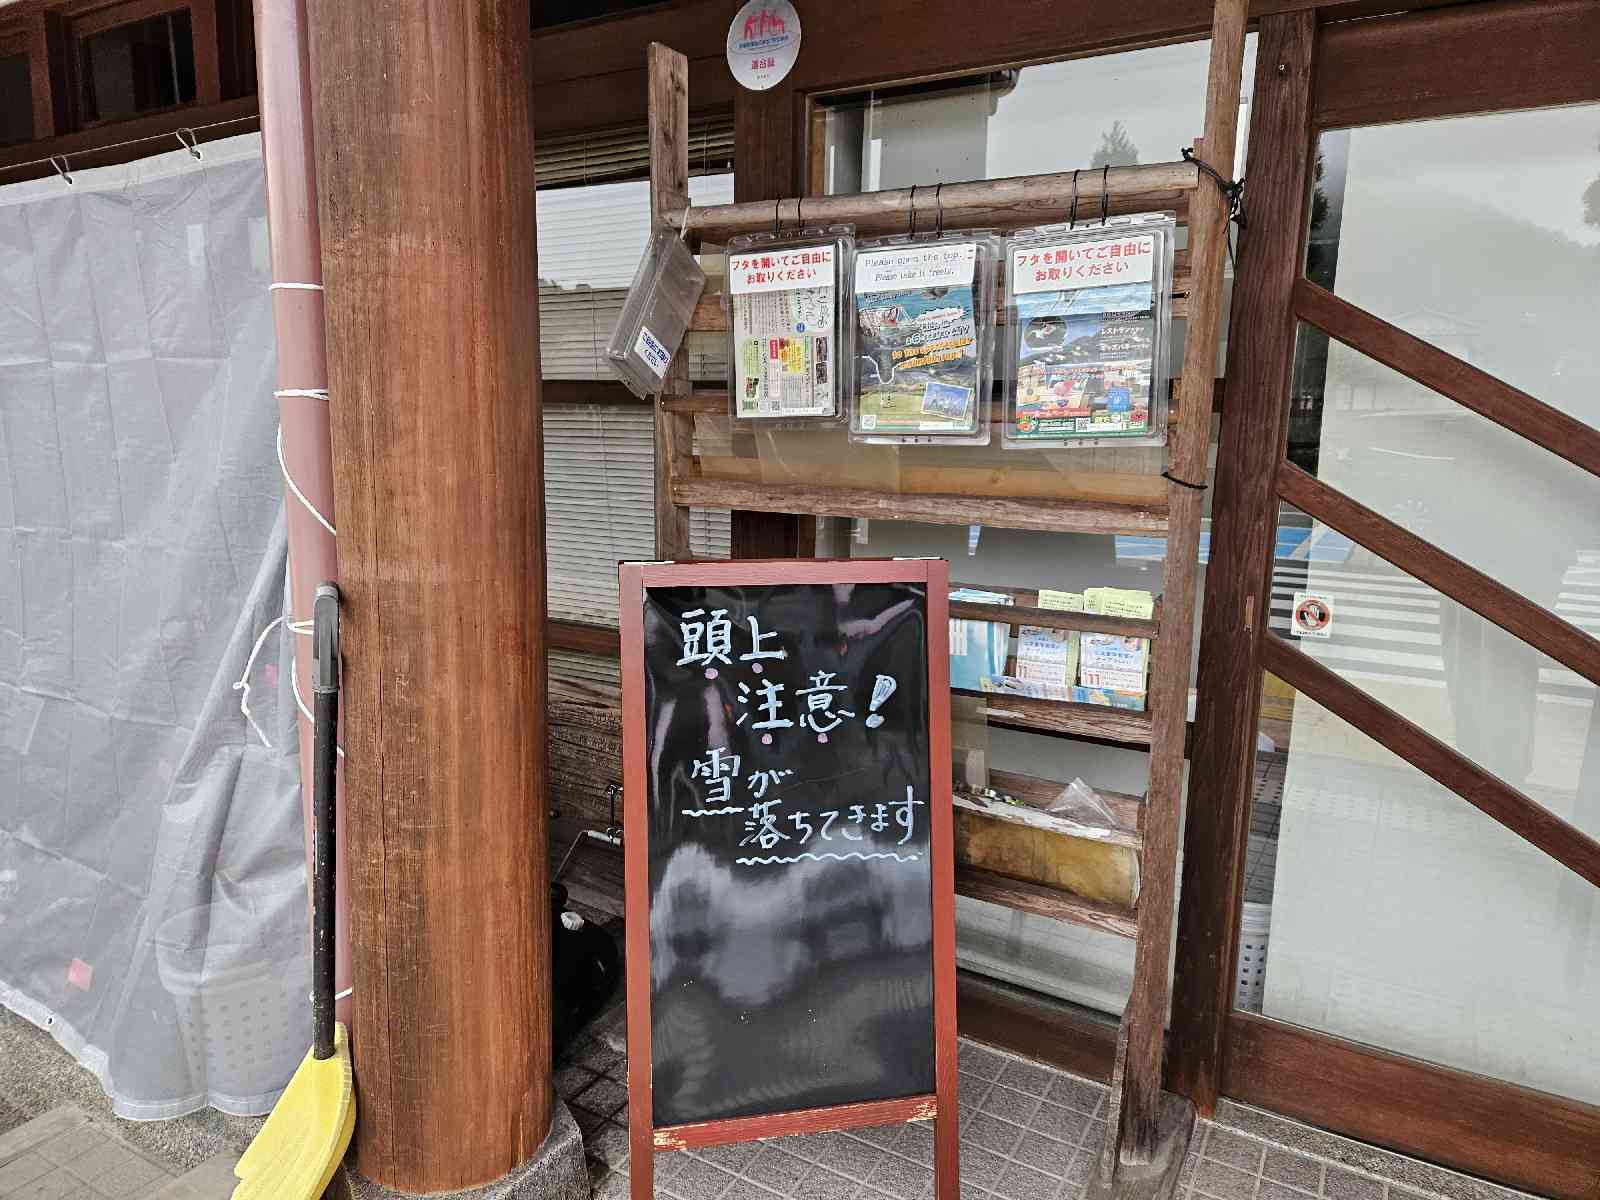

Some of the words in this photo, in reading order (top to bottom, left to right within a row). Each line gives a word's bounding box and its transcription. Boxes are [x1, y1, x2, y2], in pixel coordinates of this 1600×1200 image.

[731, 250, 832, 271] フタを開いてご自由に
[1016, 241, 1151, 265] フタを開いてご自由に
[745, 269, 817, 285] お取りください
[1034, 261, 1129, 282] お取りください
[676, 608, 788, 666] 頭上
[691, 747, 794, 803] 雪が
[738, 785, 925, 849] 落ちてきます
